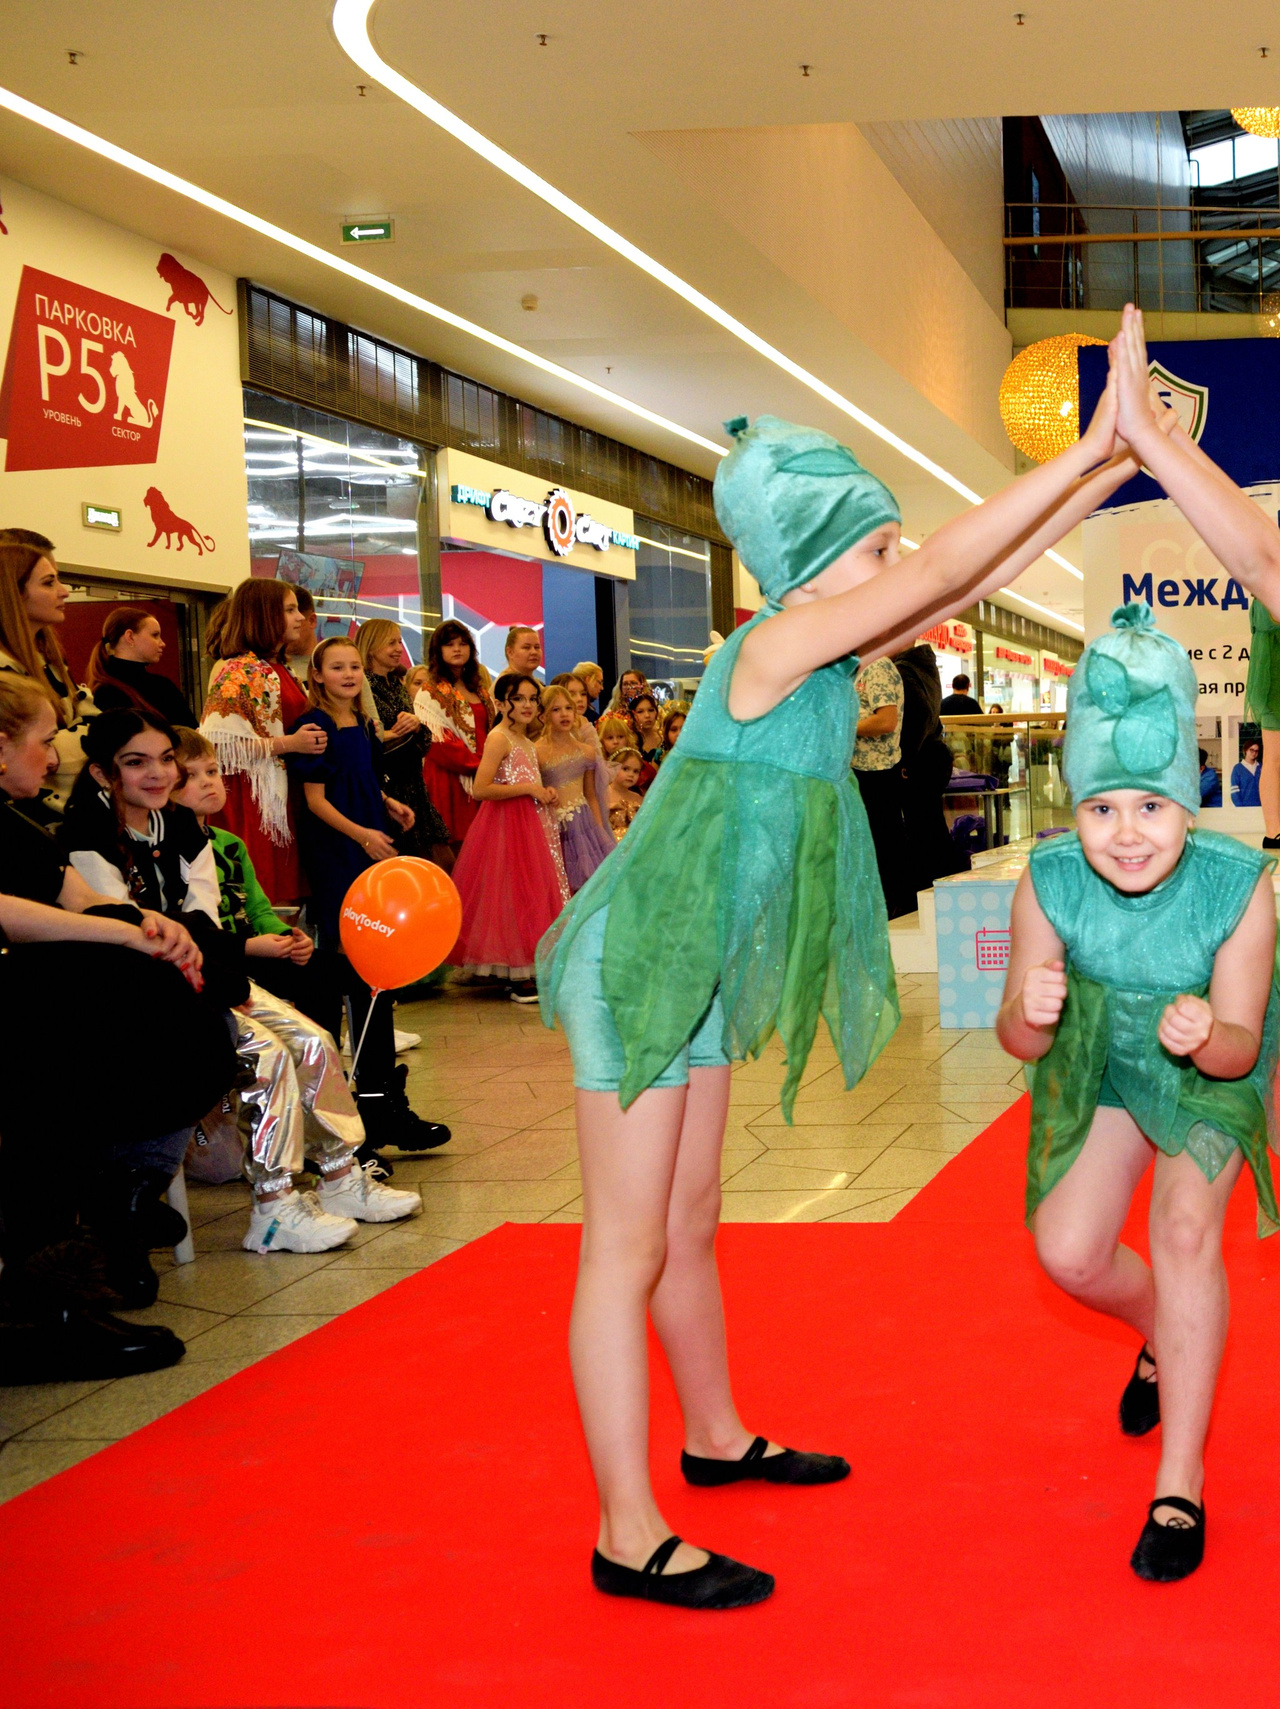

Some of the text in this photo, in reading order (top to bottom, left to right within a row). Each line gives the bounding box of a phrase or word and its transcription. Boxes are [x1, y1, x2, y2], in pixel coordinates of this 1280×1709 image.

[35, 293, 137, 348] ПАРКОВКА
[42, 408, 82, 427] УРОВЕНЬ
[111, 426, 141, 442] СЕКТОР
[456, 484, 491, 509] ДРИФТ
[1223, 644, 1233, 660] 2
[343, 907, 395, 938] playToday
